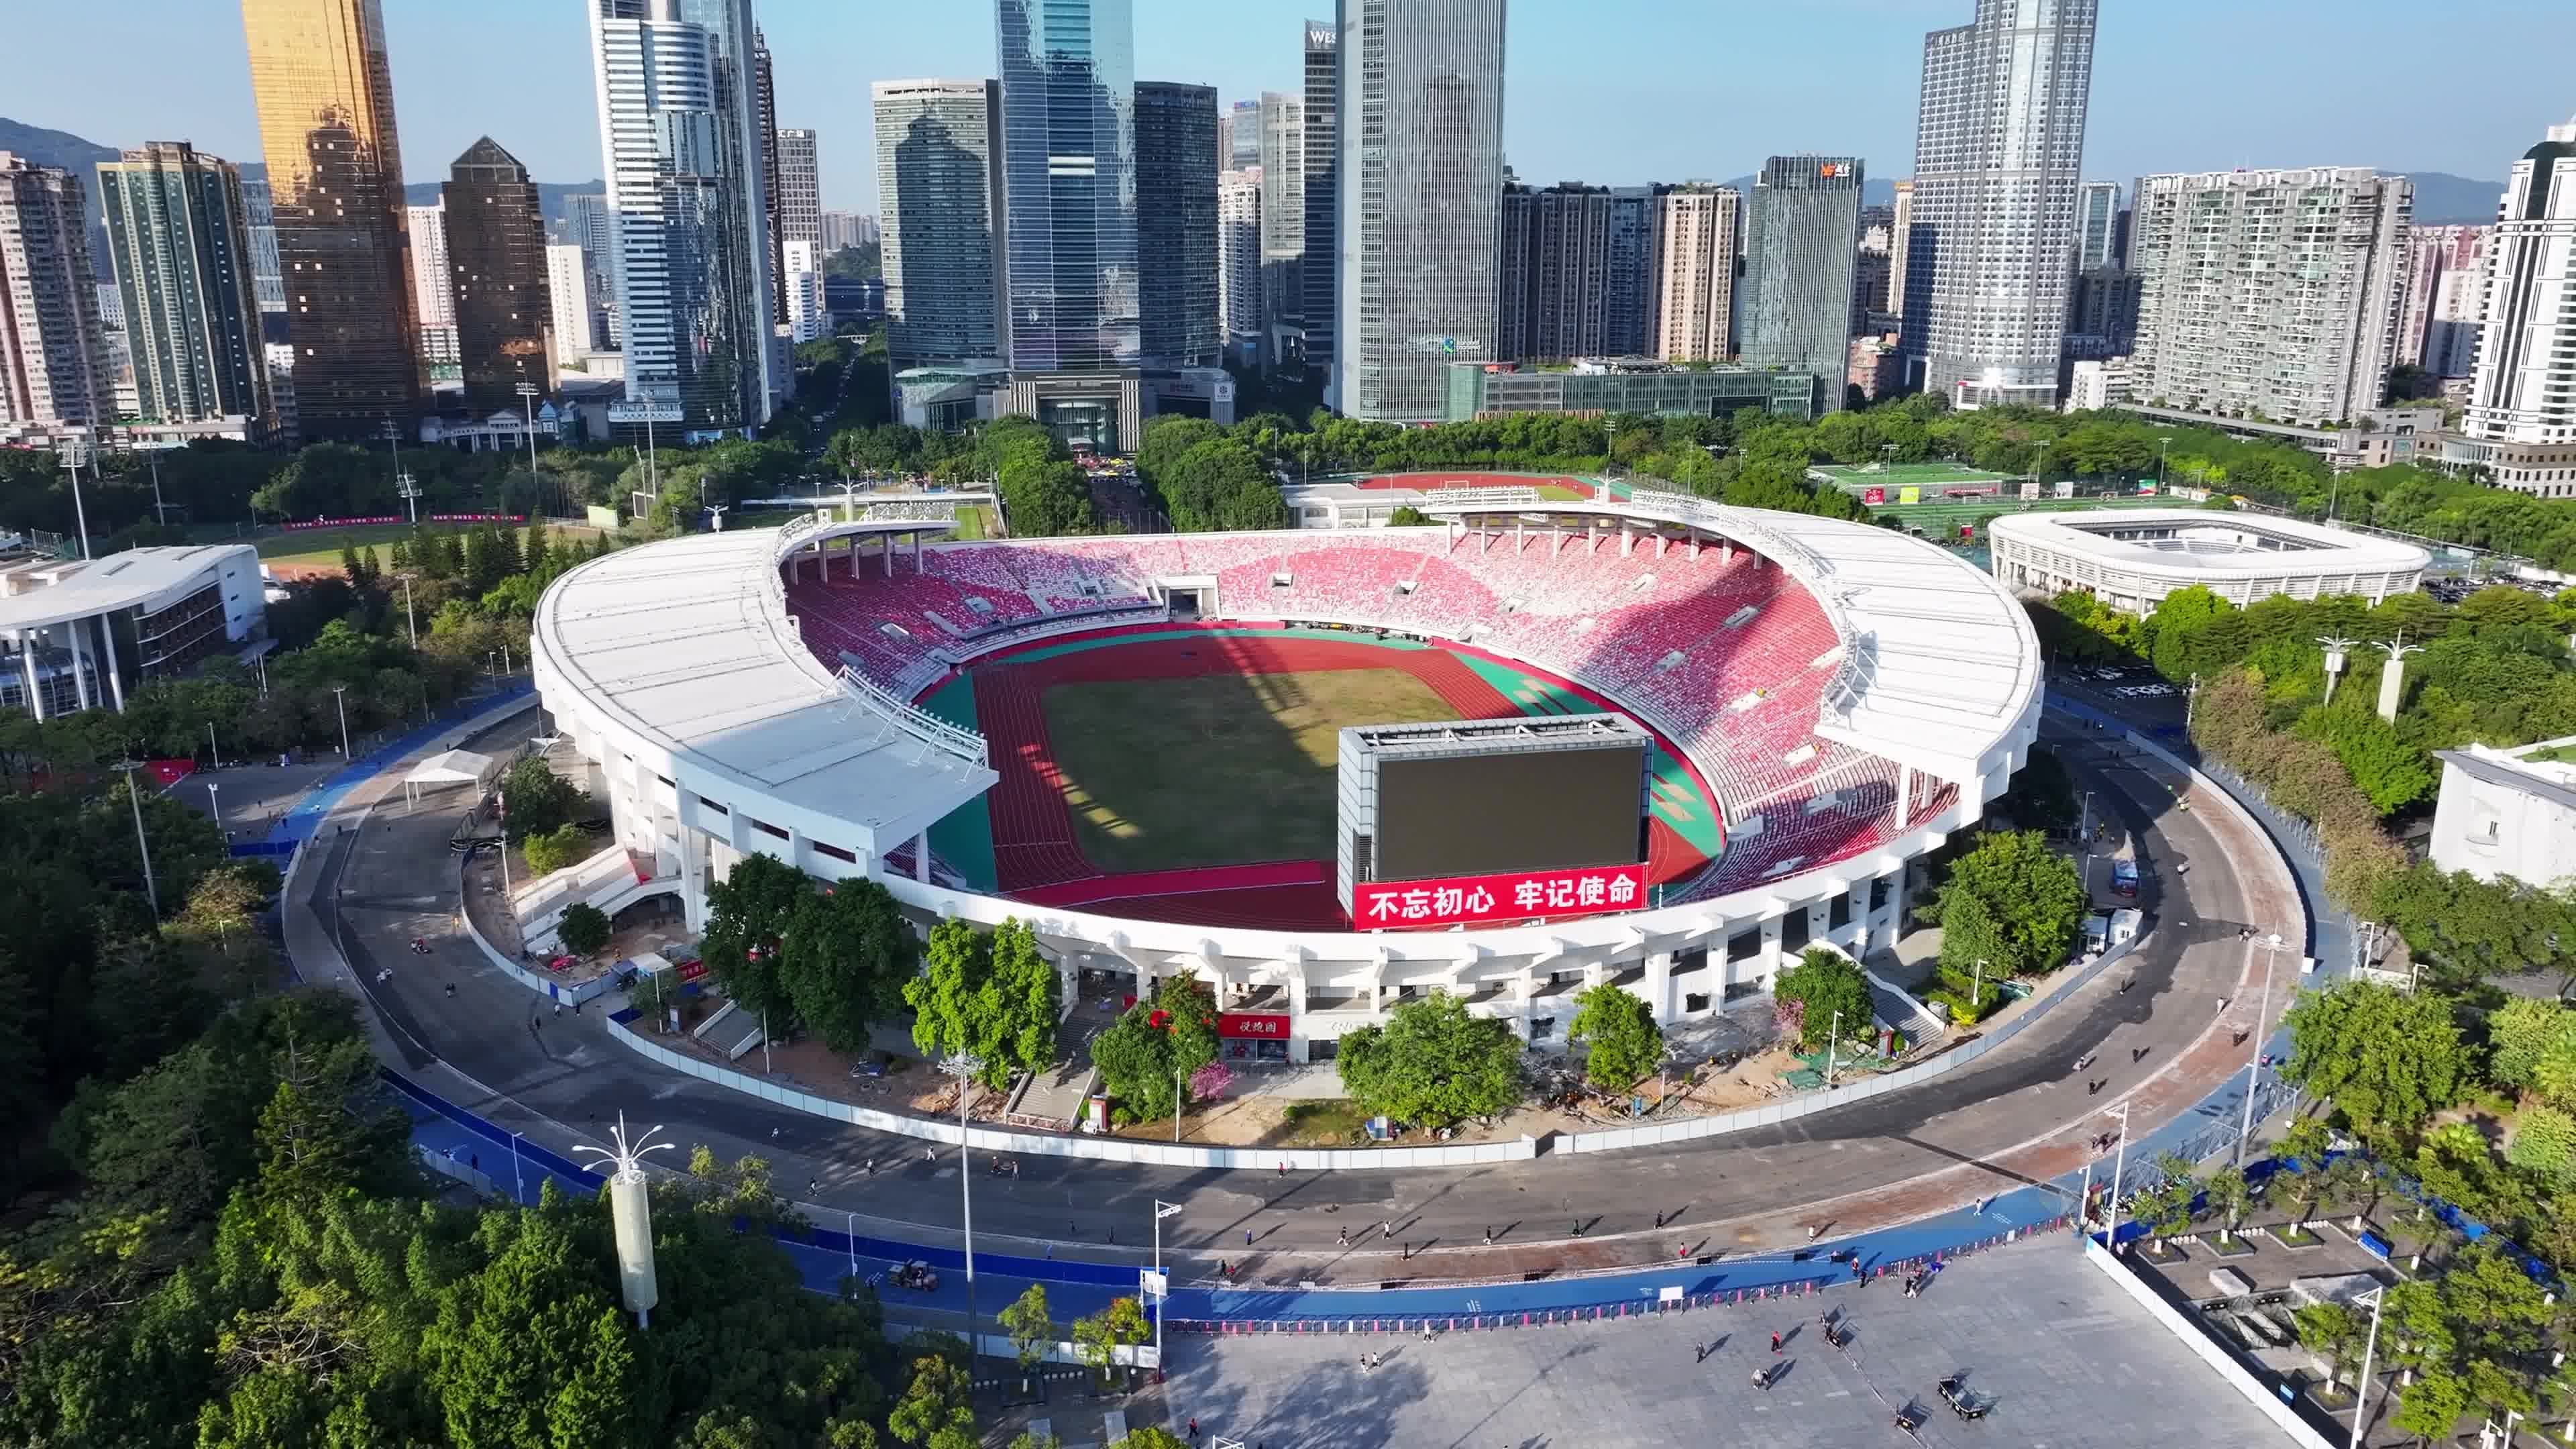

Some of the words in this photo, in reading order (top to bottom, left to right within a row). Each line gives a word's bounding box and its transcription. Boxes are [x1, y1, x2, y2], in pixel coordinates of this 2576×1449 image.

[1368, 885, 1495, 921] 不忘初心
[1514, 873, 1637, 910] 牢记使命
